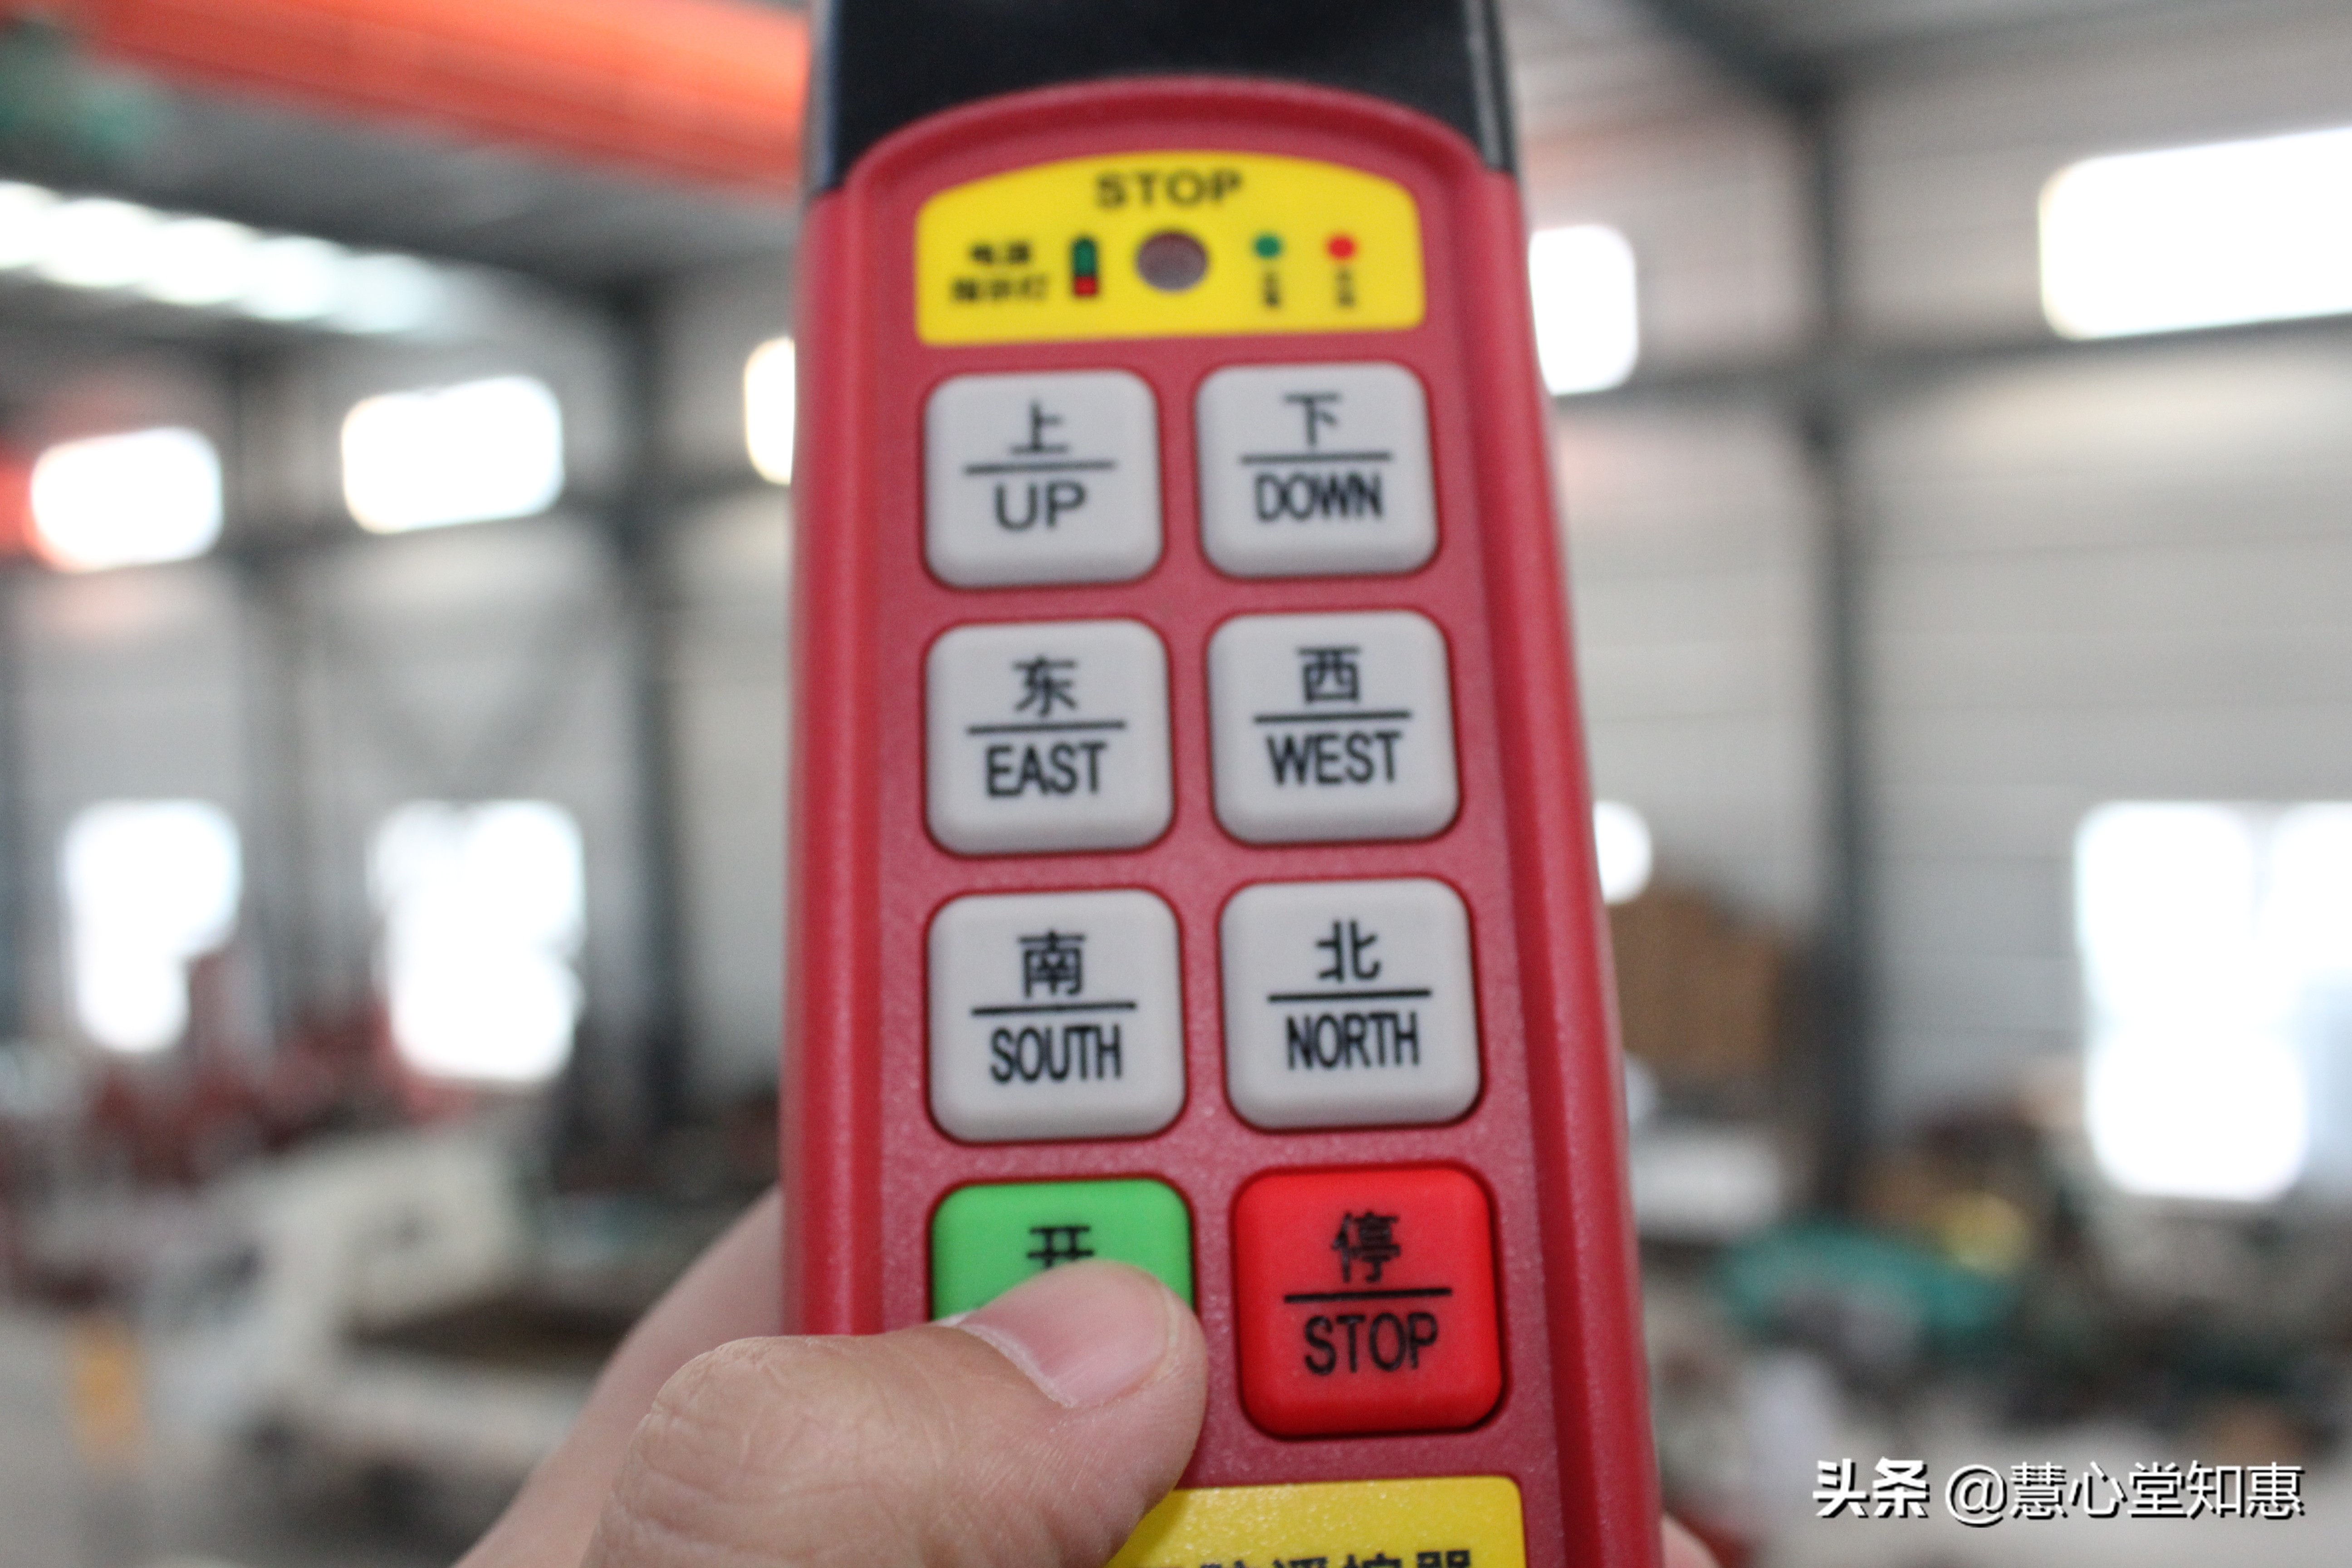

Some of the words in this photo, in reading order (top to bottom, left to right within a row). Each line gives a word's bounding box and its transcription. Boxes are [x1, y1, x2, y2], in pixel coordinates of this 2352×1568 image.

[1094, 168, 1244, 210] STOP
[1010, 399, 1068, 455] 上
[1284, 391, 1341, 449] 下
[992, 478, 1088, 534] UP
[1254, 470, 1384, 523] DOWN
[1013, 656, 1078, 717] 东
[1297, 646, 1362, 705] 西
[984, 739, 1108, 800] EAST
[1265, 729, 1402, 787] WEST
[1019, 929, 1086, 999] 南
[1315, 919, 1382, 985] 北
[989, 1022, 1123, 1086] SOUTH
[1284, 1009, 1421, 1071] NORTH
[1330, 1209, 1402, 1283] 停
[1303, 1309, 1440, 1378] STOP
